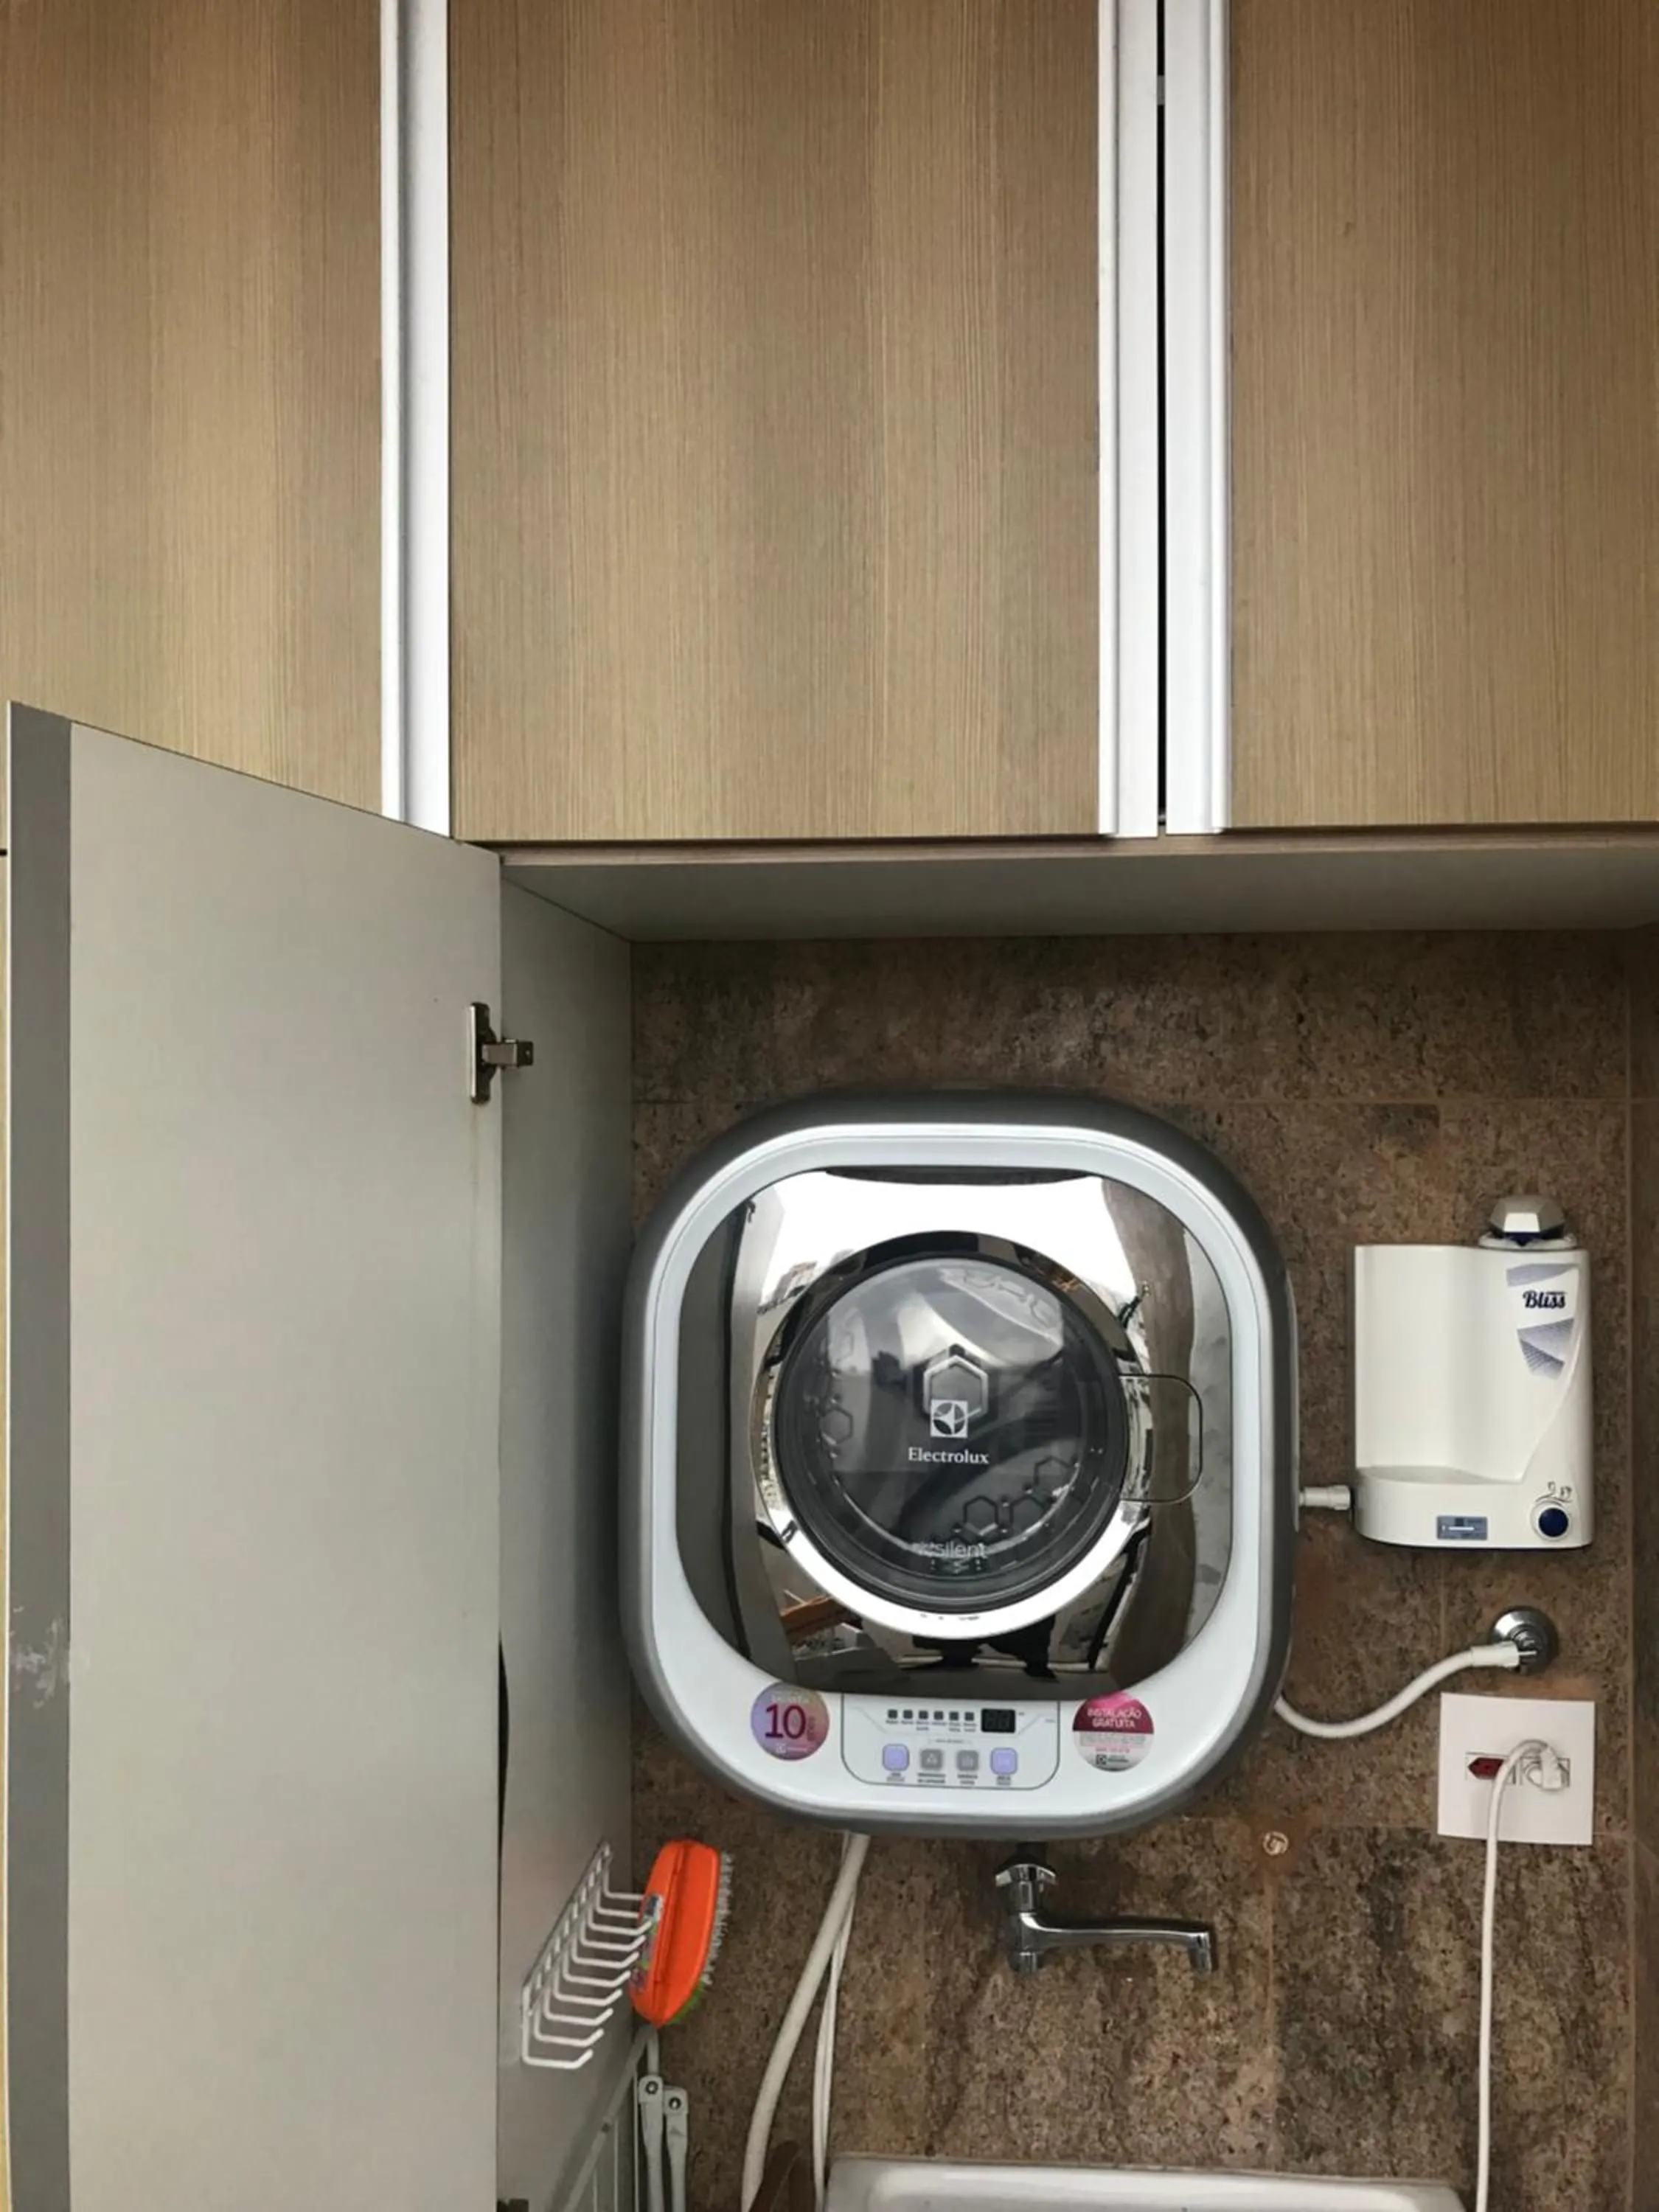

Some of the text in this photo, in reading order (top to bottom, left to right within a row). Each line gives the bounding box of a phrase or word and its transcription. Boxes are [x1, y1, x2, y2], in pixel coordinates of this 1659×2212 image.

[1523, 1290, 1567, 1309] Bliss
[908, 1447, 990, 1464] Electrolux
[765, 1703, 807, 1740] 10
[1092, 1717, 1135, 1728] GRATUITA
